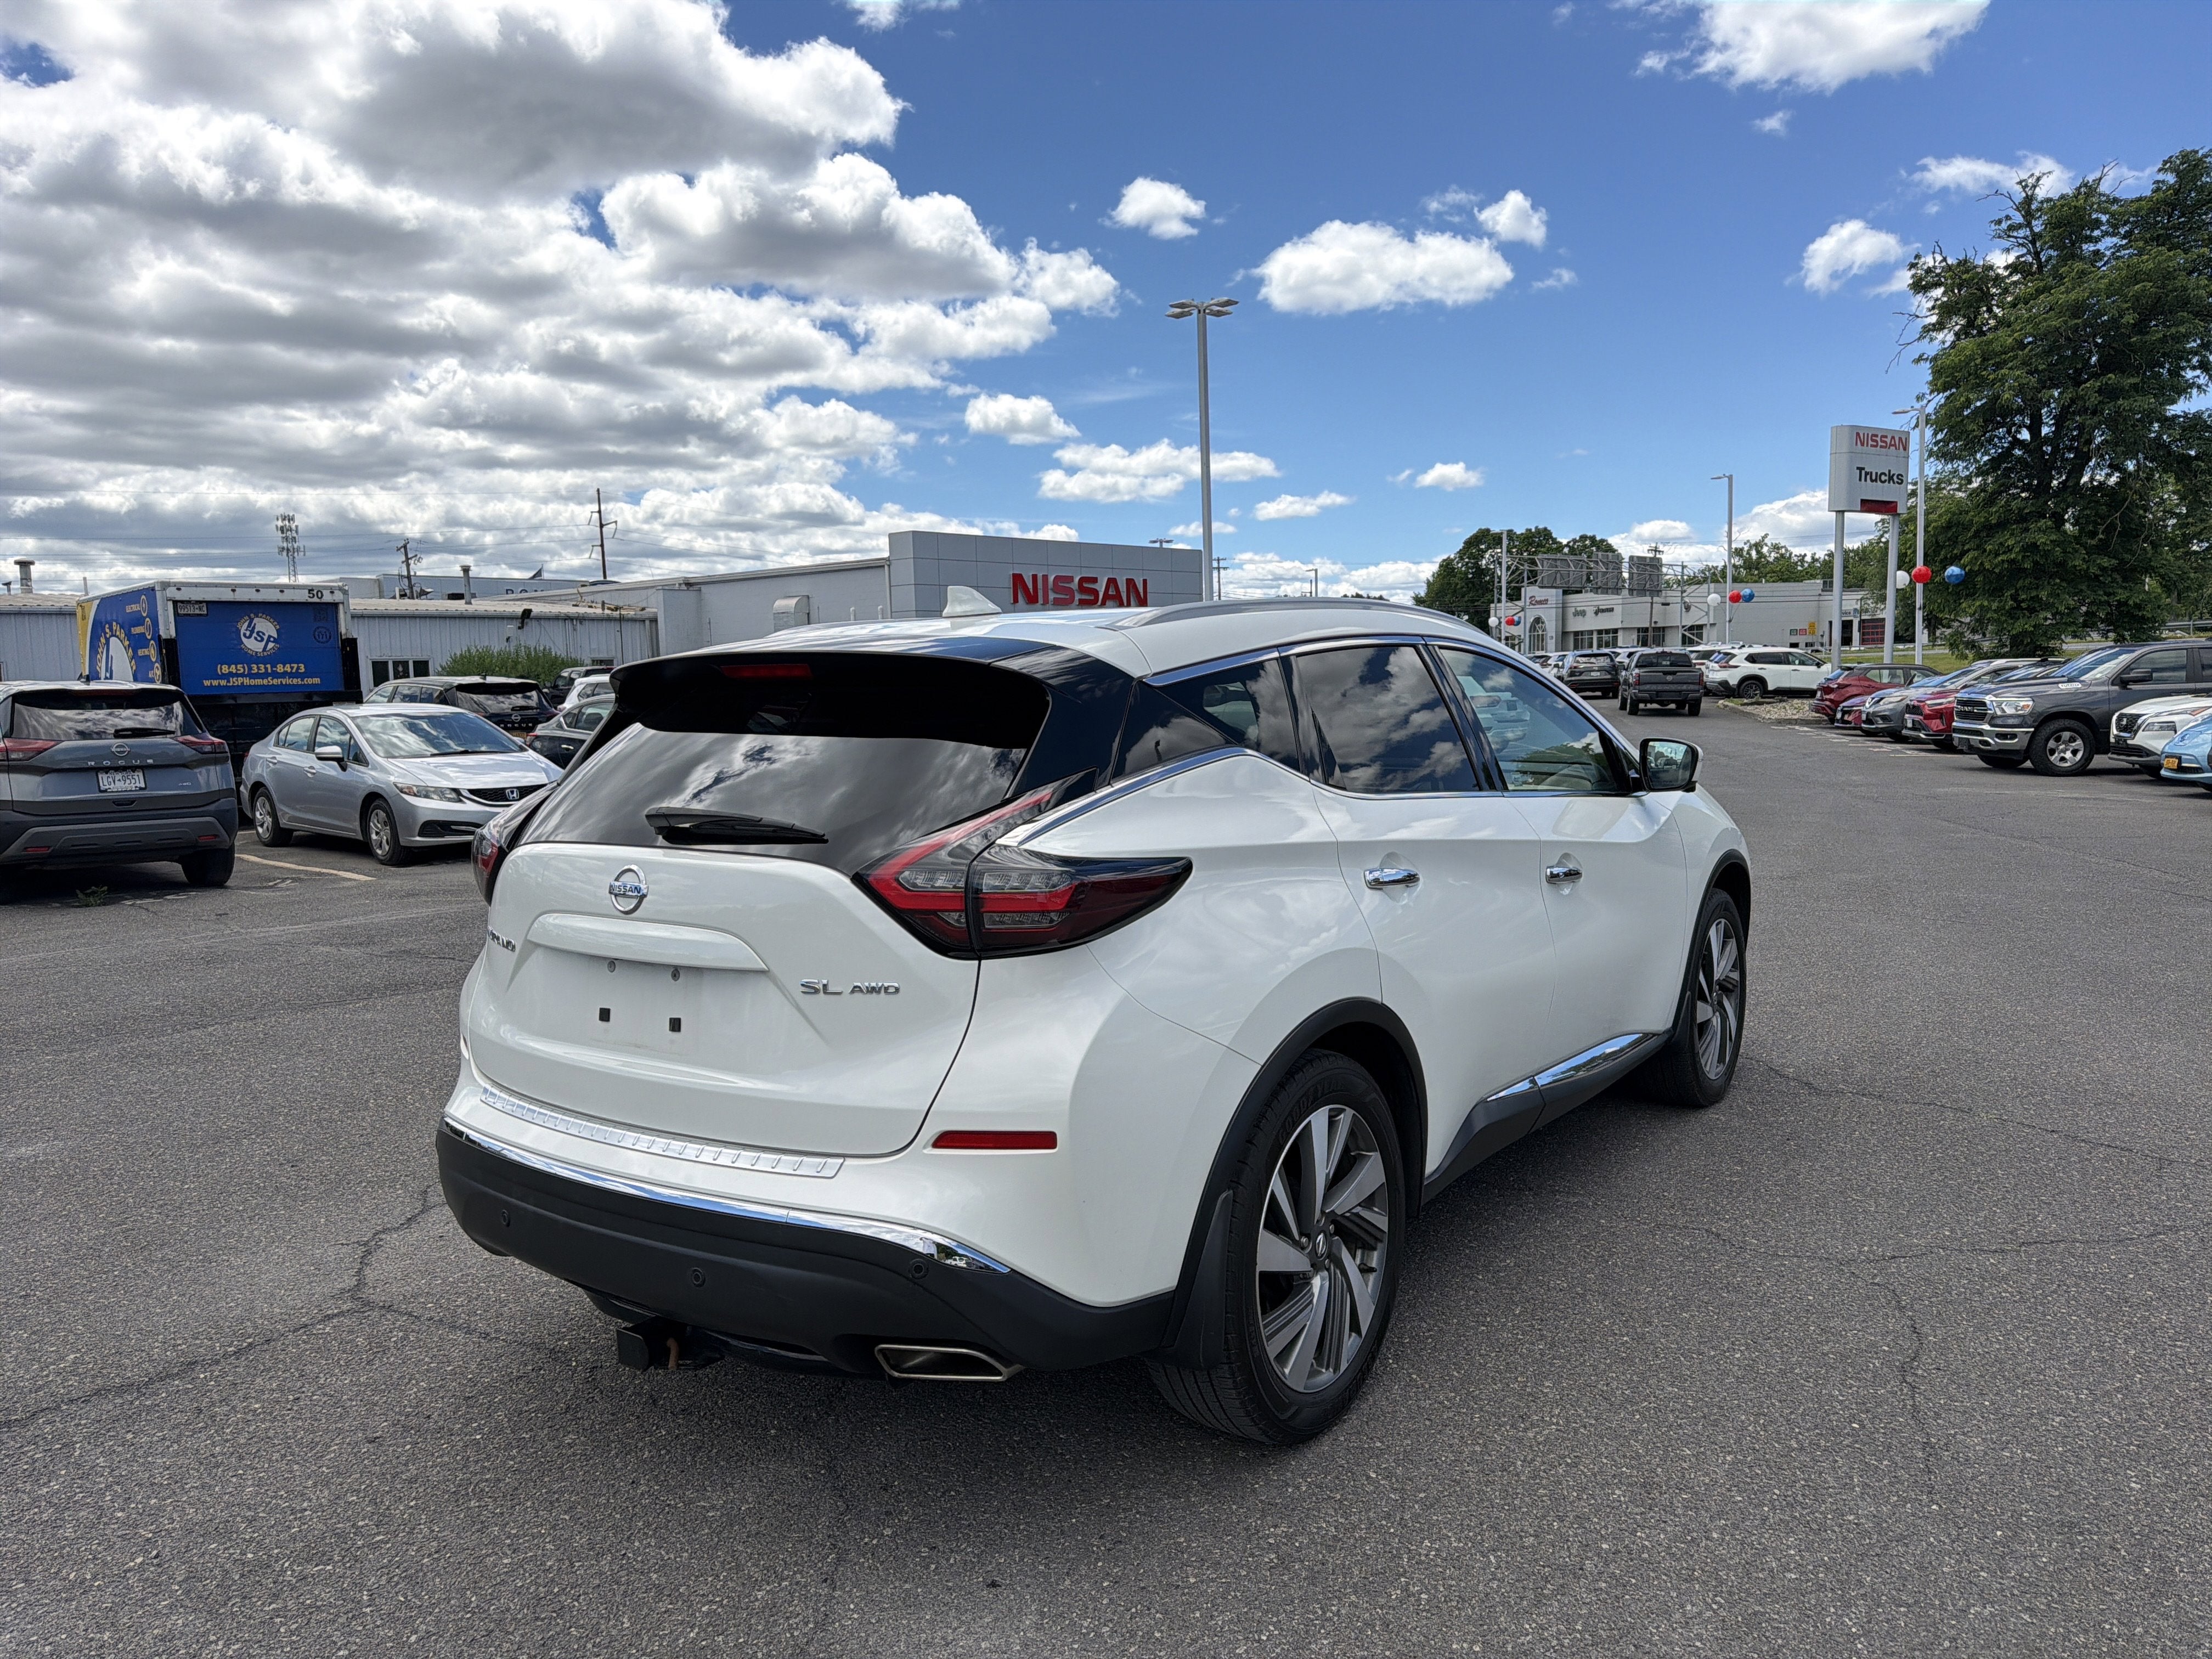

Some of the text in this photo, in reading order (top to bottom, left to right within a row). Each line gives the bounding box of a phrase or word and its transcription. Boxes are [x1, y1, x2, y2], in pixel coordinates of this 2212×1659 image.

[1855, 431, 1908, 452] NISSAN
[1856, 466, 1904, 485] Trucks
[308, 589, 324, 599] 50
[1011, 573, 1148, 606] NISSAN
[1572, 608, 1587, 618] Jeep
[237, 616, 249, 630] JOHN
[258, 613, 280, 630] PARKER
[97, 622, 136, 678] JOHN S. PARKER
[241, 644, 280, 657] HOME SERVICES
[217, 663, 305, 675] (845) 331-8473
[203, 676, 320, 686] www.JSPHomeServices.com
[610, 884, 641, 894] NISSAN
[799, 979, 900, 995] SL AWD
